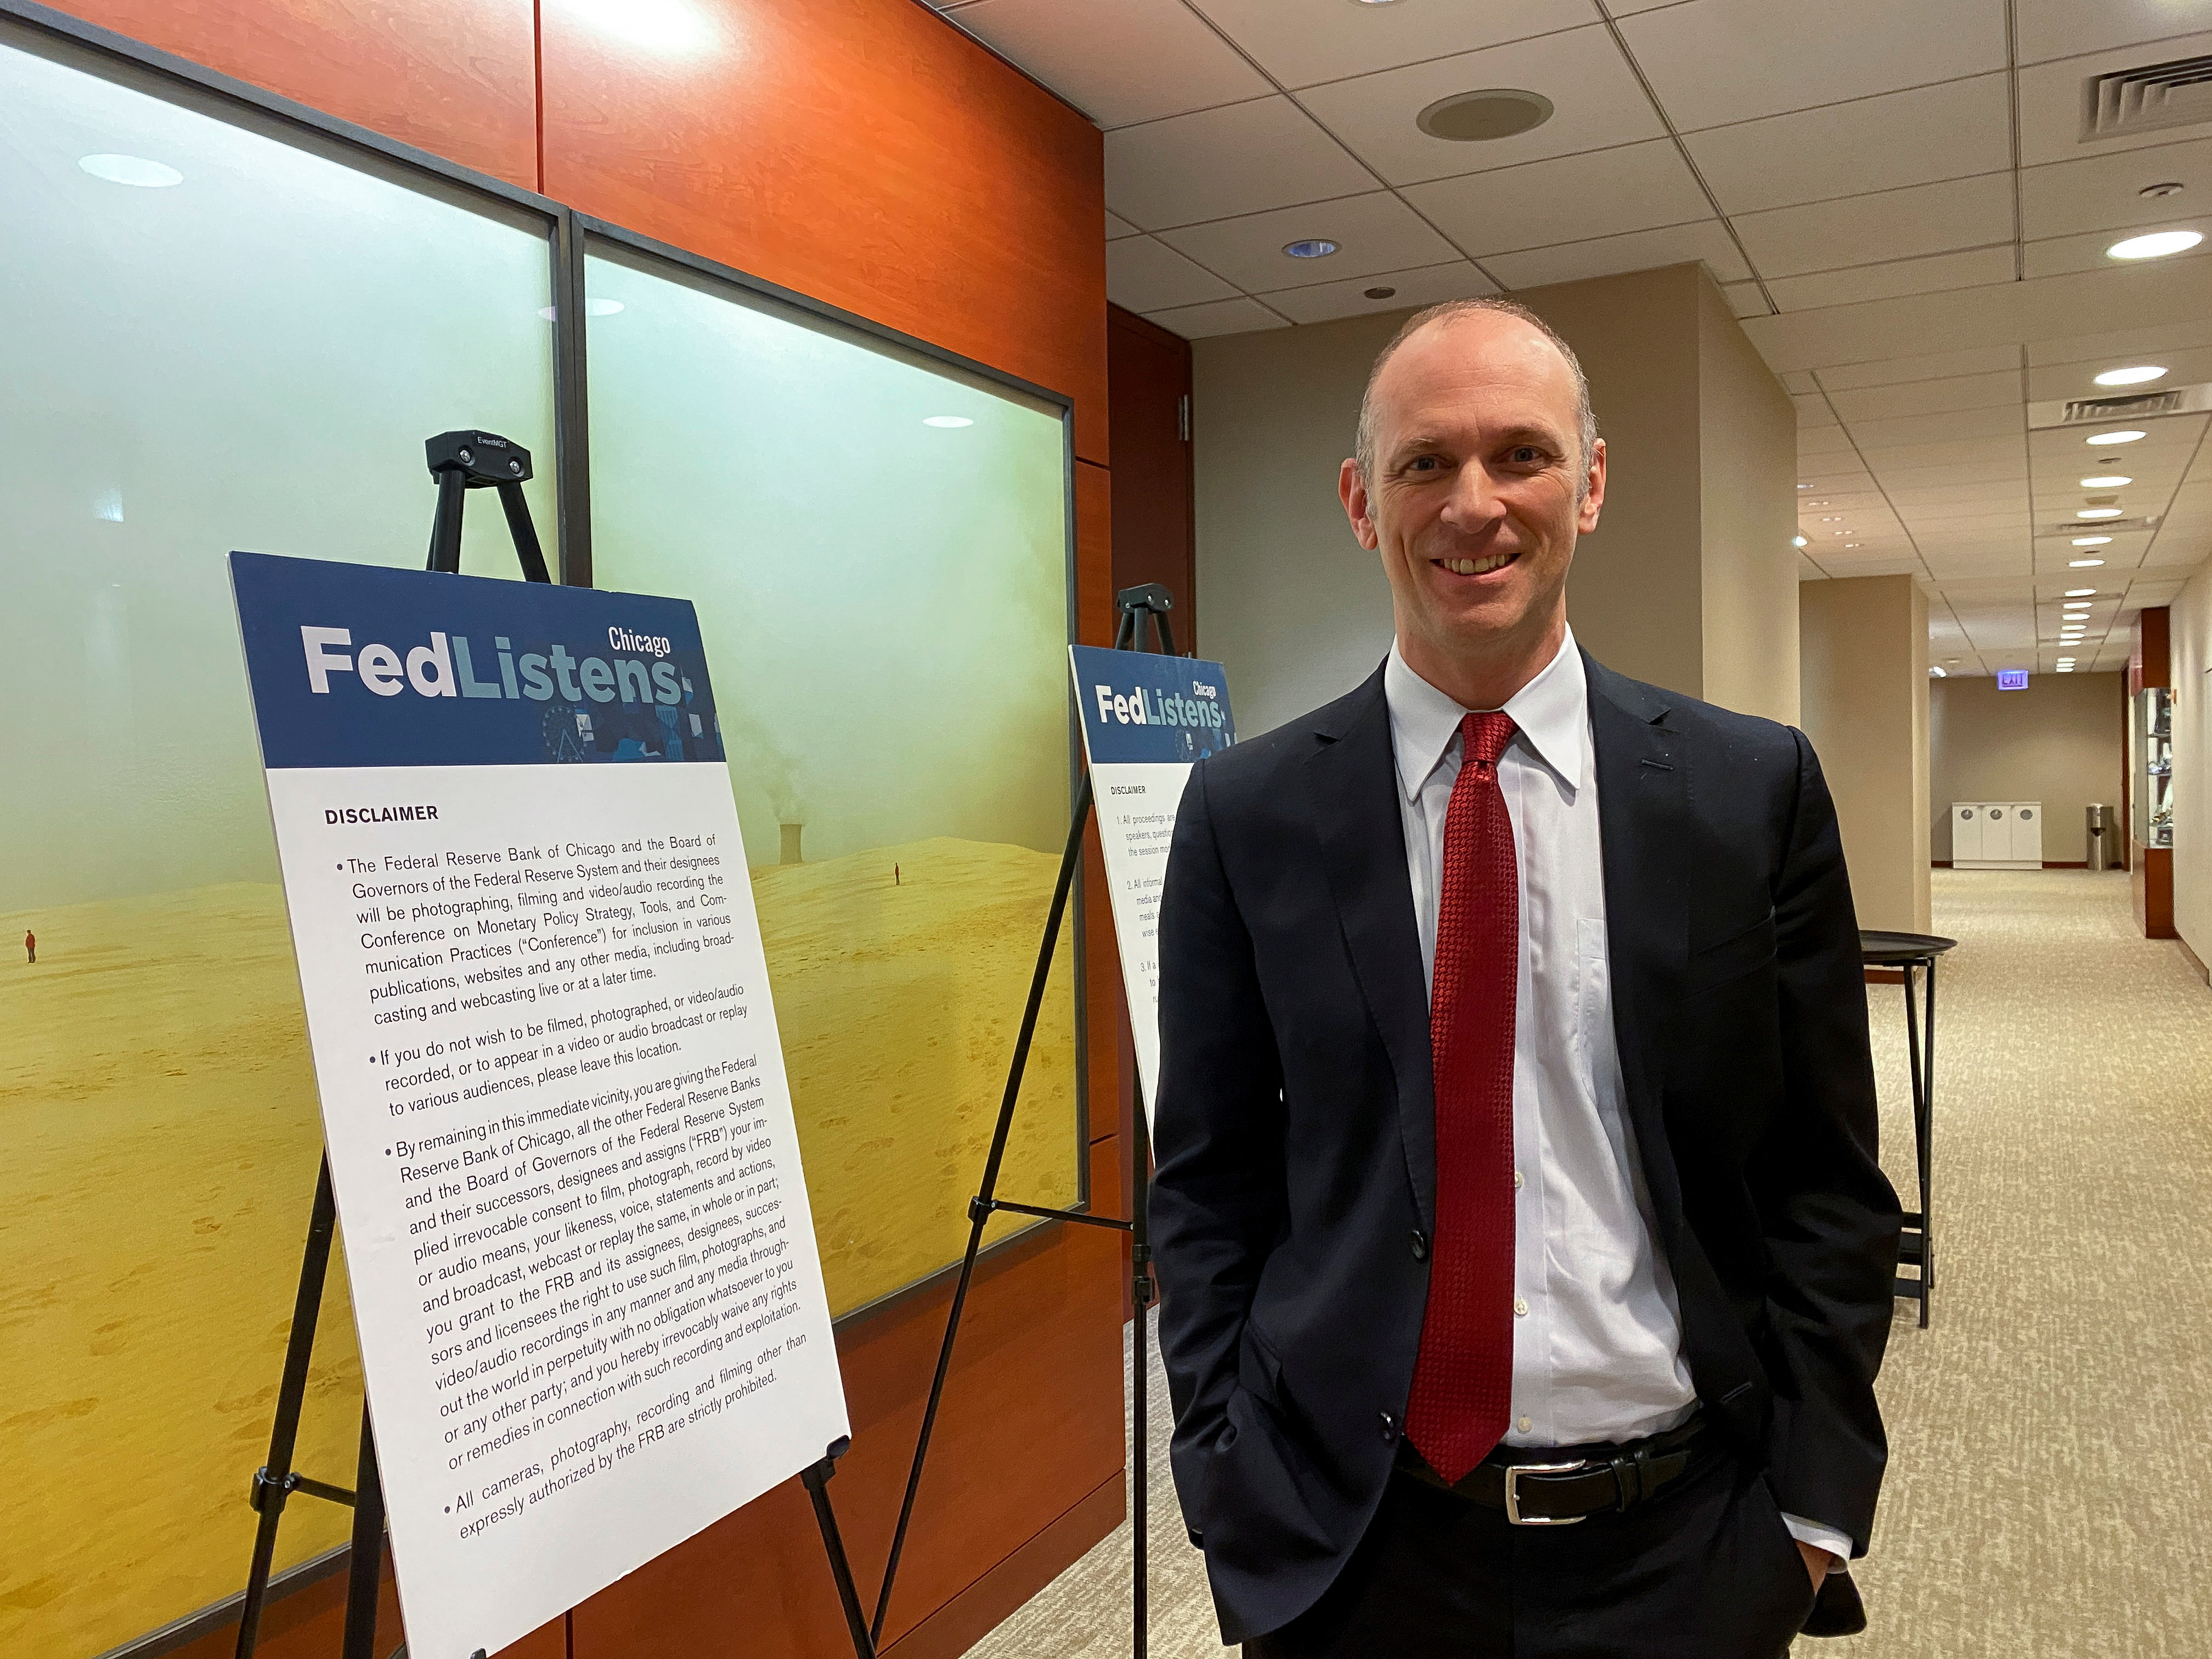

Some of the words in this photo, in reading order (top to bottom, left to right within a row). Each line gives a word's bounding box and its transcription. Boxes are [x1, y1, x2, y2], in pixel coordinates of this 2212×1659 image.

[477, 437, 507, 448] EventMGT
[608, 627, 671, 658] Chicago
[300, 625, 681, 705] FedListens
[2002, 674, 2023, 685] EXIT
[1095, 685, 1222, 728] FedListens
[1193, 681, 1216, 699] Chicago
[1110, 786, 1146, 795] DISCLAIMER
[325, 805, 438, 825] DISCLAIMER
[1133, 813, 1165, 826] proceedings
[346, 858, 376, 874] The
[384, 853, 439, 871] Federal
[445, 851, 501, 866] Reserve
[507, 845, 543, 861] Bank
[548, 844, 560, 859] of
[566, 842, 616, 858] Chicago
[621, 838, 642, 853] and
[646, 837, 665, 850] the
[669, 834, 702, 849] Board
[706, 833, 716, 846] of
[1126, 830, 1152, 843] speakers,
[1128, 847, 1138, 857] the
[1139, 845, 1159, 856] session
[352, 882, 428, 899] Governors
[432, 876, 445, 891] of
[449, 874, 471, 890] the
[473, 870, 522, 888] Federal
[524, 869, 574, 883] Reserve
[576, 864, 619, 881] System
[621, 859, 642, 874] and
[644, 857, 667, 872] their
[669, 855, 720, 871] designees
[1127, 881, 1133, 890] 2.
[1142, 876, 1163, 887] informal
[356, 907, 381, 924] will
[386, 906, 405, 921] be
[411, 895, 513, 923] photographing,
[517, 890, 558, 907] filming
[562, 886, 585, 902] and
[588, 879, 652, 899] video/audio
[656, 875, 705, 891] recording
[707, 873, 724, 886] the
[1136, 894, 1152, 905] media
[1139, 910, 1155, 921] meals
[360, 929, 445, 949] Conference
[453, 926, 470, 938] on
[477, 917, 537, 935] Monetary
[543, 911, 579, 927] Policy
[585, 906, 635, 921] Strategy,
[639, 899, 672, 915] Tools,
[676, 895, 696, 910] and
[700, 894, 727, 907] Com-
[1142, 927, 1154, 938] wise
[365, 951, 443, 974] munication
[449, 943, 512, 963] Practices
[612, 926, 627, 940] for
[631, 920, 679, 937] inclusion
[682, 917, 692, 930] in
[696, 913, 731, 928] various
[370, 975, 460, 1005] publications,
[464, 965, 523, 985] websites
[528, 958, 551, 975] and
[555, 958, 575, 973] any
[580, 952, 610, 967] other
[614, 944, 651, 962] media,
[652, 938, 701, 956] including
[702, 931, 735, 947] broad-
[1140, 962, 1147, 972] 3.
[1150, 978, 1156, 987] to
[374, 1004, 427, 1025] casting
[431, 997, 457, 1015] and
[460, 986, 536, 1010] webcasting
[538, 982, 559, 997] live
[562, 981, 575, 992] or
[578, 977, 590, 990] at
[592, 978, 601, 988] a
[602, 972, 627, 986] later
[630, 967, 656, 981] time.
[380, 1049, 390, 1065] If
[394, 1048, 421, 1068] you
[426, 1041, 444, 1057] do
[449, 1036, 471, 1053] not
[475, 1028, 506, 1047] wish
[510, 1027, 523, 1040] to
[527, 1023, 544, 1037] be
[547, 1013, 587, 1033] filmed,
[590, 996, 672, 1029] photographed,
[674, 997, 685, 1008] or
[687, 983, 744, 1005] video/audio
[388, 1102, 404, 1116] to
[408, 1092, 459, 1112] various
[463, 1076, 534, 1100] audiences,
[537, 1065, 578, 1087] please
[579, 1058, 611, 1073] leave
[613, 1049, 634, 1065] this
[636, 1041, 681, 1060] location.
[396, 1141, 415, 1160] By
[419, 1125, 487, 1153] remaining
[487, 1119, 500, 1135] in
[501, 1113, 526, 1131] this
[526, 1099, 590, 1125] immediate
[591, 1088, 633, 1108] vicinity,
[633, 1084, 653, 1102] you
[654, 1079, 672, 1092] are
[673, 1070, 704, 1091] giving
[704, 1065, 721, 1079] the
[721, 1053, 757, 1075] Federal
[419, 1271, 433, 1286] or
[438, 1255, 477, 1280] audio
[482, 1242, 530, 1266] means,
[533, 1229, 561, 1252] your
[565, 1213, 617, 1238] likeness,
[619, 1200, 653, 1218] voice,
[656, 1178, 714, 1206] statements
[716, 1167, 736, 1186] and
[738, 1159, 776, 1178] actions,
[449, 1454, 463, 1470] or
[467, 1425, 530, 1462] remedies
[532, 1416, 544, 1432] in
[547, 1386, 616, 1425] connection
[617, 1370, 642, 1392] with
[644, 1357, 671, 1380] such
[673, 1336, 723, 1368] recording
[725, 1323, 744, 1344] and
[745, 1302, 801, 1334] exploitation.
[456, 1489, 474, 1514] All
[482, 1463, 544, 1499] cameras,
[550, 1420, 631, 1471] photography,
[636, 1391, 690, 1425] recording
[695, 1374, 715, 1396] and
[719, 1360, 753, 1384] filming
[757, 1345, 782, 1365] other
[786, 1334, 806, 1351] than
[460, 1496, 524, 1539] expressly
[529, 1457, 595, 1505] authorized
[597, 1452, 613, 1470] by
[616, 1443, 635, 1460] the
[637, 1424, 665, 1449] FRB
[668, 1418, 685, 1434] are
[688, 1397, 722, 1424] strictly
[725, 1368, 777, 1409] prohibited.
